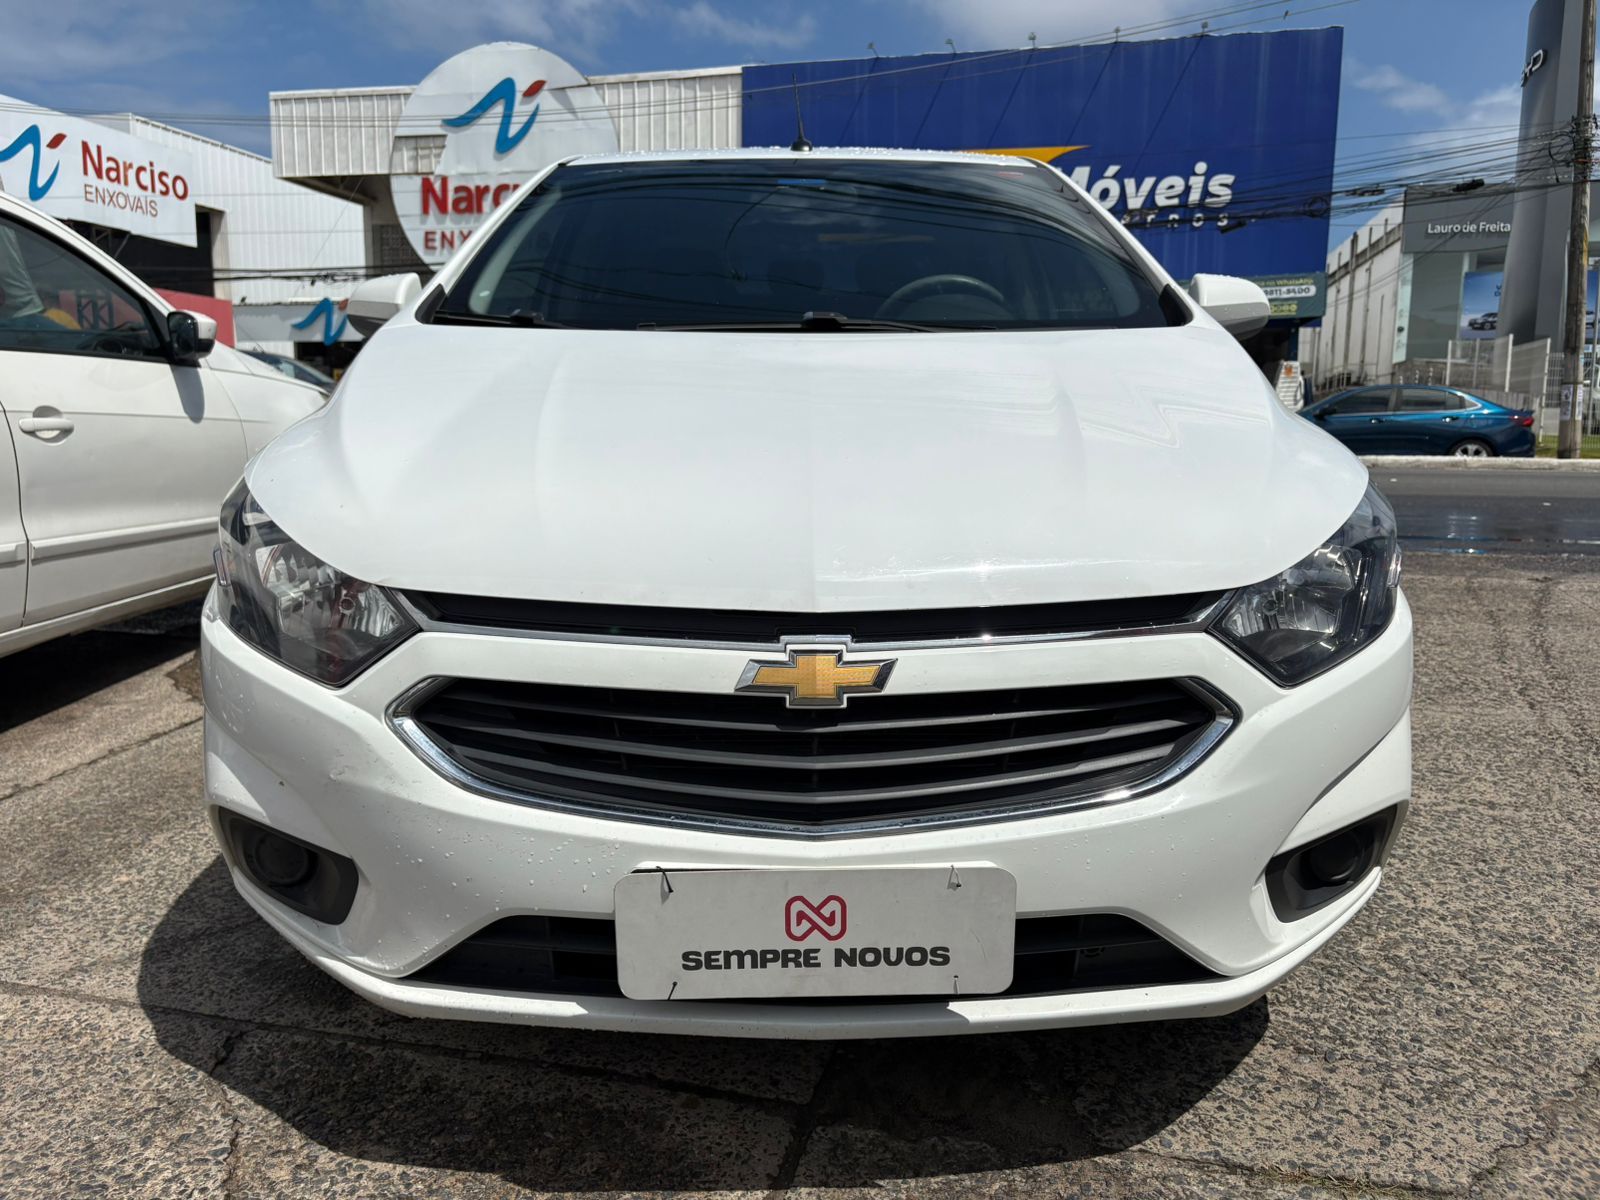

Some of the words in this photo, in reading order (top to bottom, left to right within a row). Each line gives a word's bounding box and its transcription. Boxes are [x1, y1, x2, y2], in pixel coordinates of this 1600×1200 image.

[81, 139, 189, 201] Narciso
[84, 183, 159, 218] ENXOVAIS
[421, 175, 522, 216] Narc
[1427, 223, 1461, 234] Lauro
[1462, 221, 1477, 233] de
[681, 948, 821, 971] SEMPRE
[834, 946, 950, 968] NOVOS
